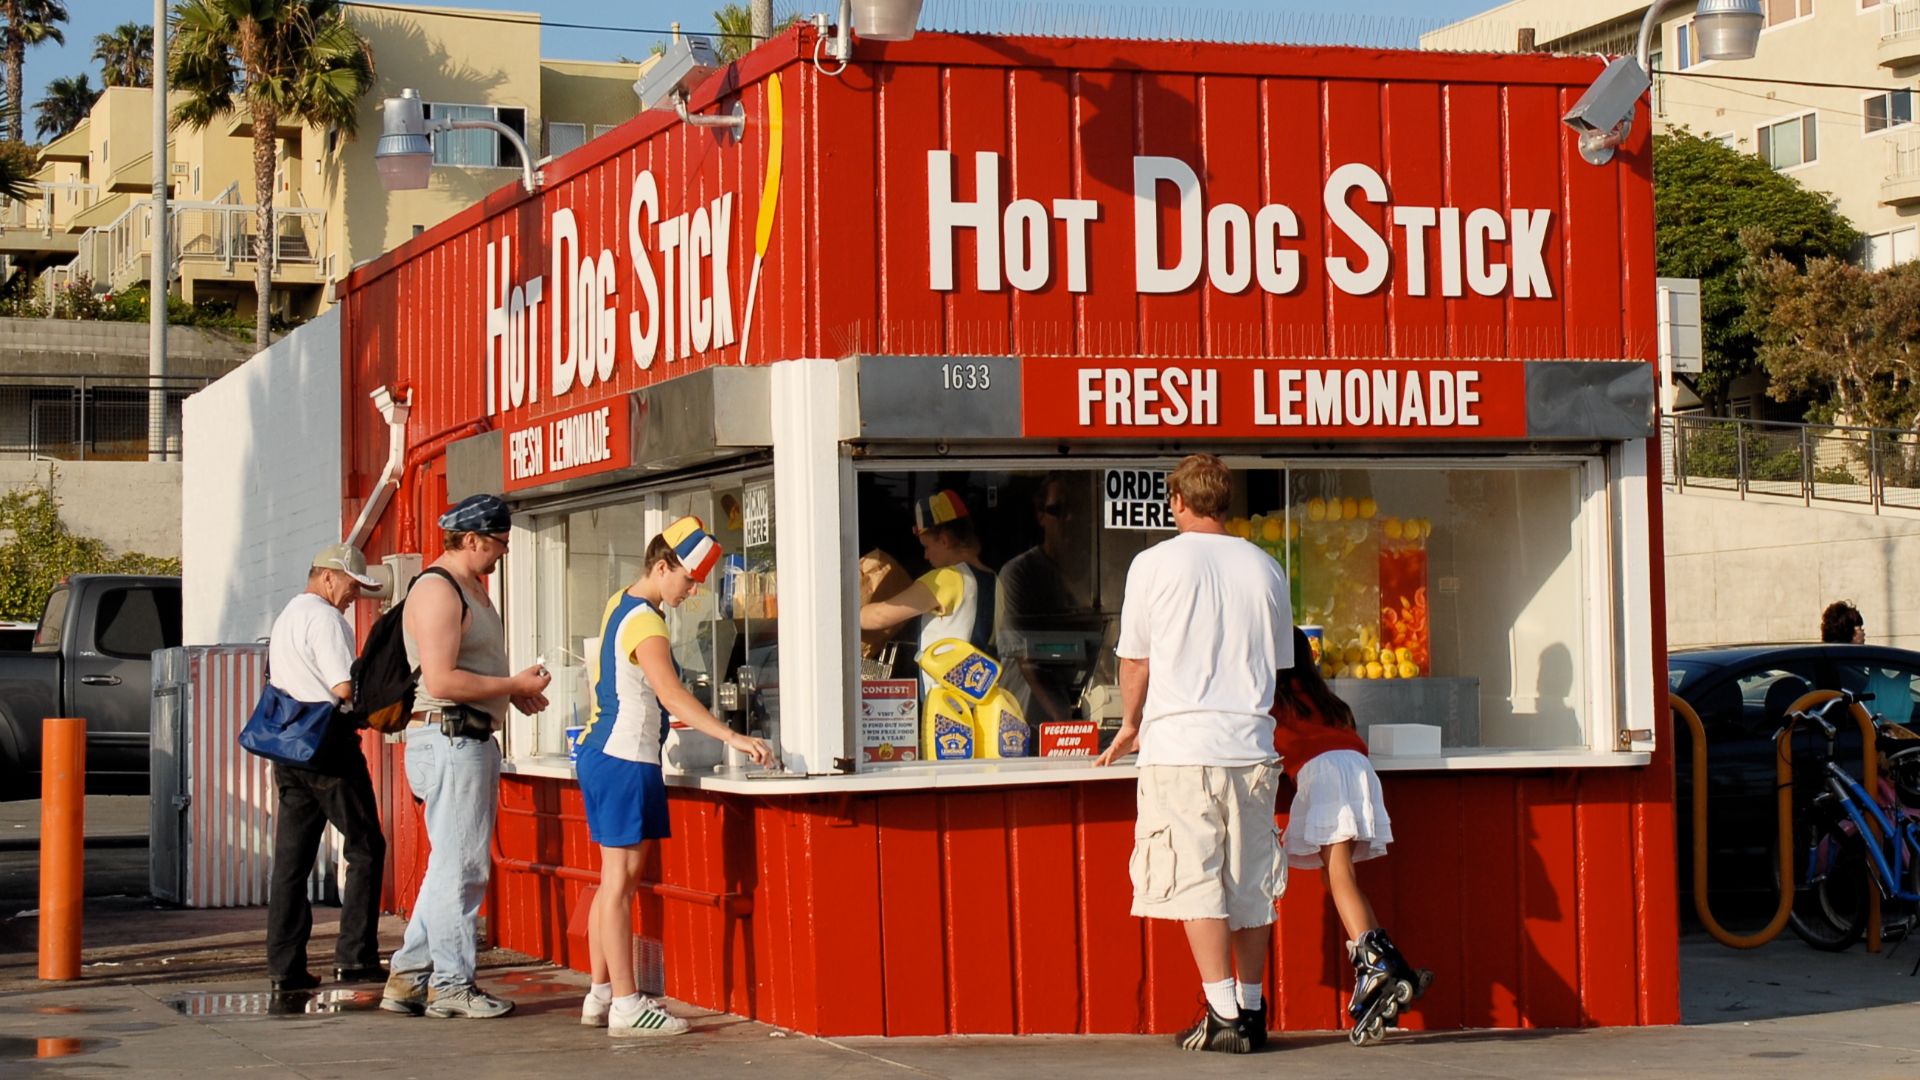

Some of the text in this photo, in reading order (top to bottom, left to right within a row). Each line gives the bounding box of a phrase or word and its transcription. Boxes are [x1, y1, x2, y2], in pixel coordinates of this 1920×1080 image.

[927, 150, 1552, 298] HOT DOG STICK
[487, 169, 735, 416] HOT DOG STICK
[942, 363, 990, 389] 1633
[1078, 366, 1480, 426] FRESH LEMONADE
[509, 406, 611, 480] FRESH LEMONADE
[1106, 470, 1169, 500] ORDE
[1111, 501, 1177, 527] HERE
[746, 517, 767, 546] HERE
[862, 686, 910, 694] CONTEST!
[1045, 725, 1094, 735] VEGETARIAN
[1056, 736, 1081, 747] MENU
[1047, 747, 1091, 757] AVAILABLE
